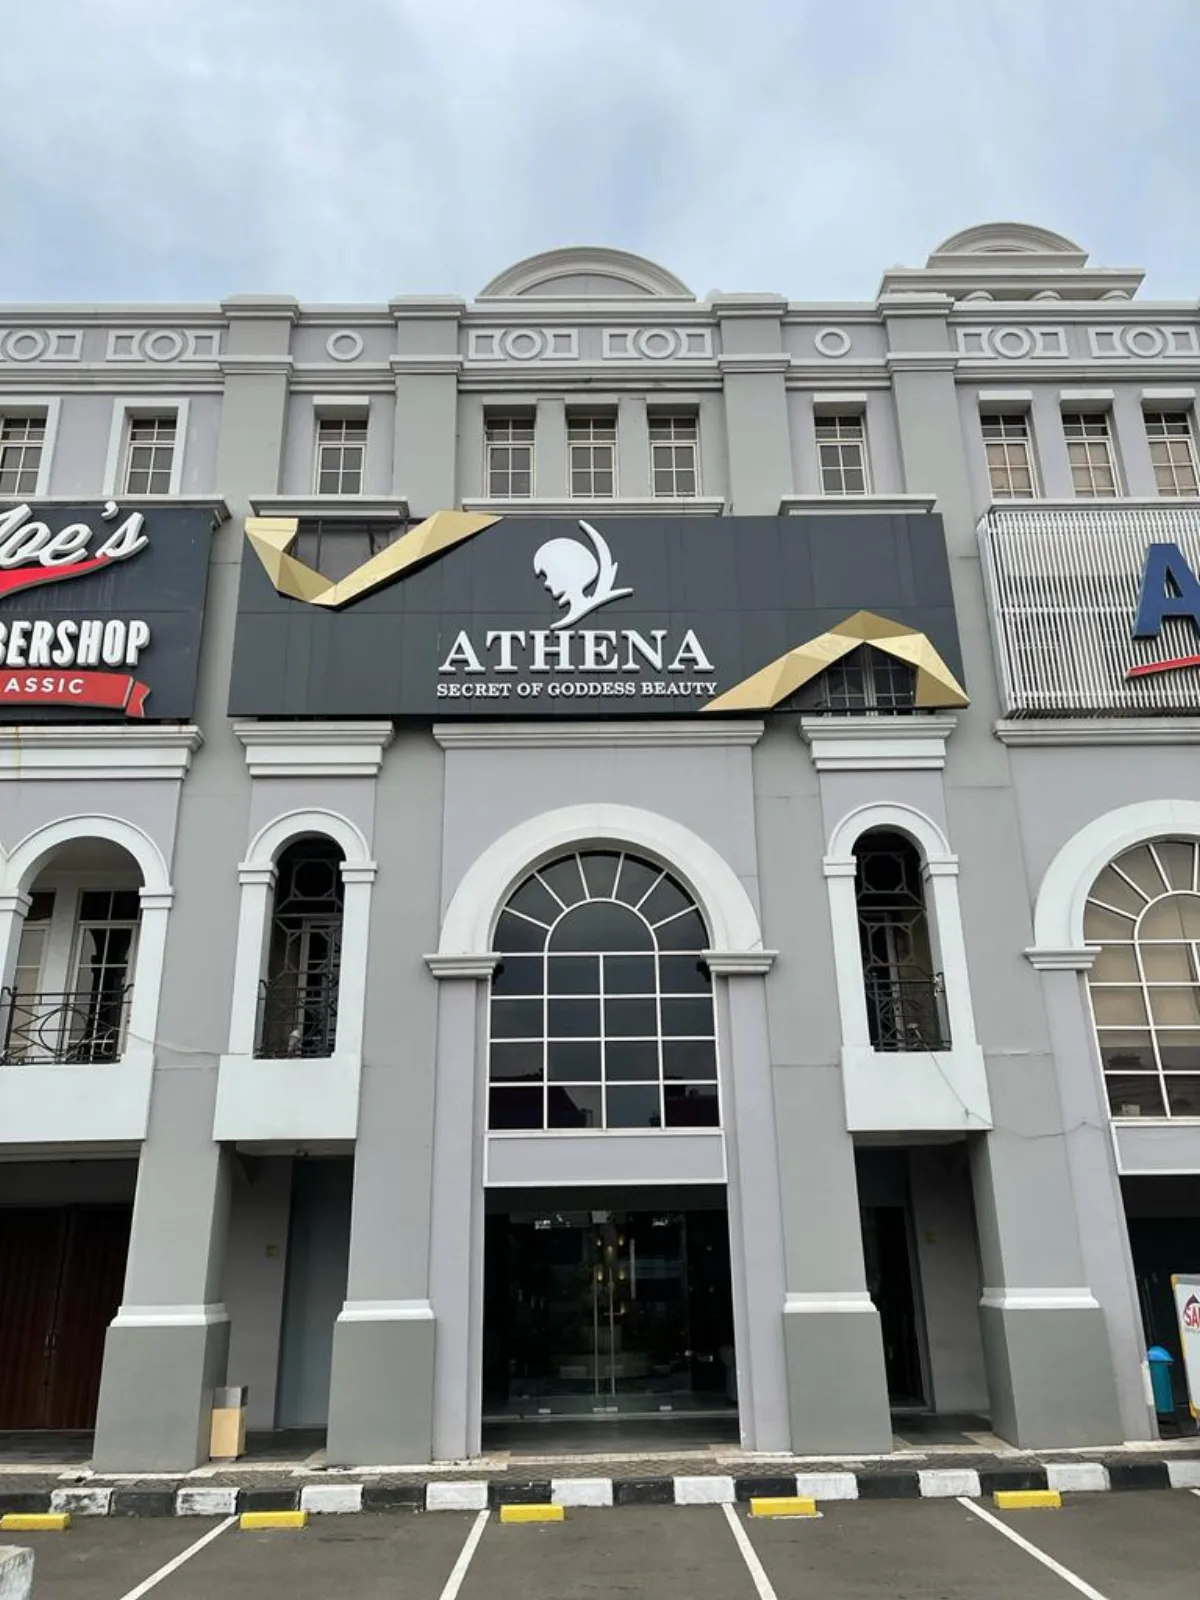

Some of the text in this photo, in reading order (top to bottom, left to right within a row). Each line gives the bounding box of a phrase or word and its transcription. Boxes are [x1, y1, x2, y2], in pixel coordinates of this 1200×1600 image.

[438, 629, 715, 673] ATHENA
[437, 681, 717, 697] SECRET OF GODDESS BEAUTY
[1184, 1304, 1200, 1328] SA
